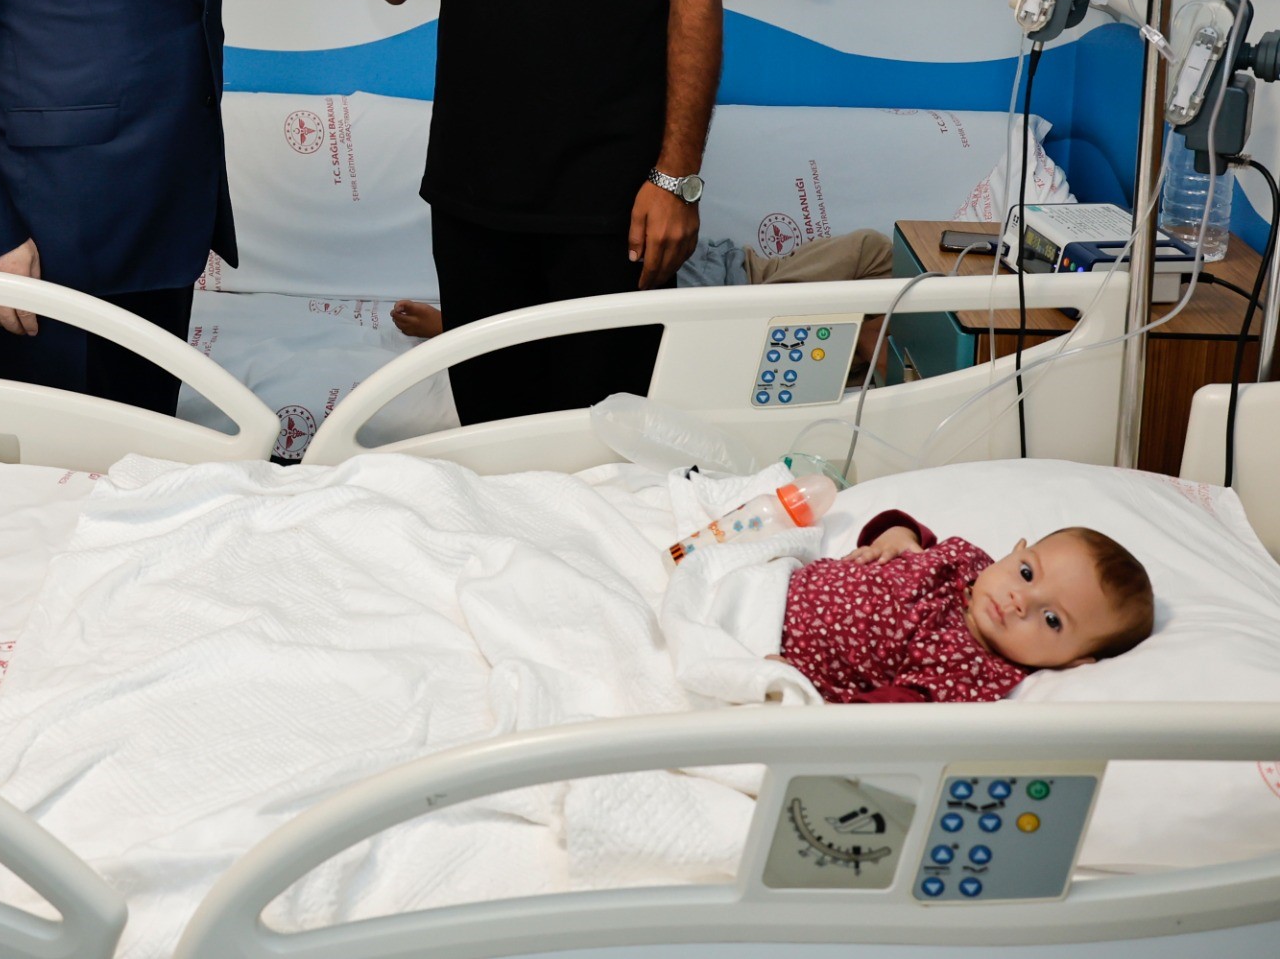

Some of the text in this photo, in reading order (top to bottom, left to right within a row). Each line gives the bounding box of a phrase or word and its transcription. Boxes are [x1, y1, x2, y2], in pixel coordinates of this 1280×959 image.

[329, 132, 340, 166] SAĞLIK
[346, 143, 354, 152] VE
[333, 167, 342, 185] T.C.
[795, 178, 814, 235] BAKANLIĞI
[815, 221, 824, 238] ANA
